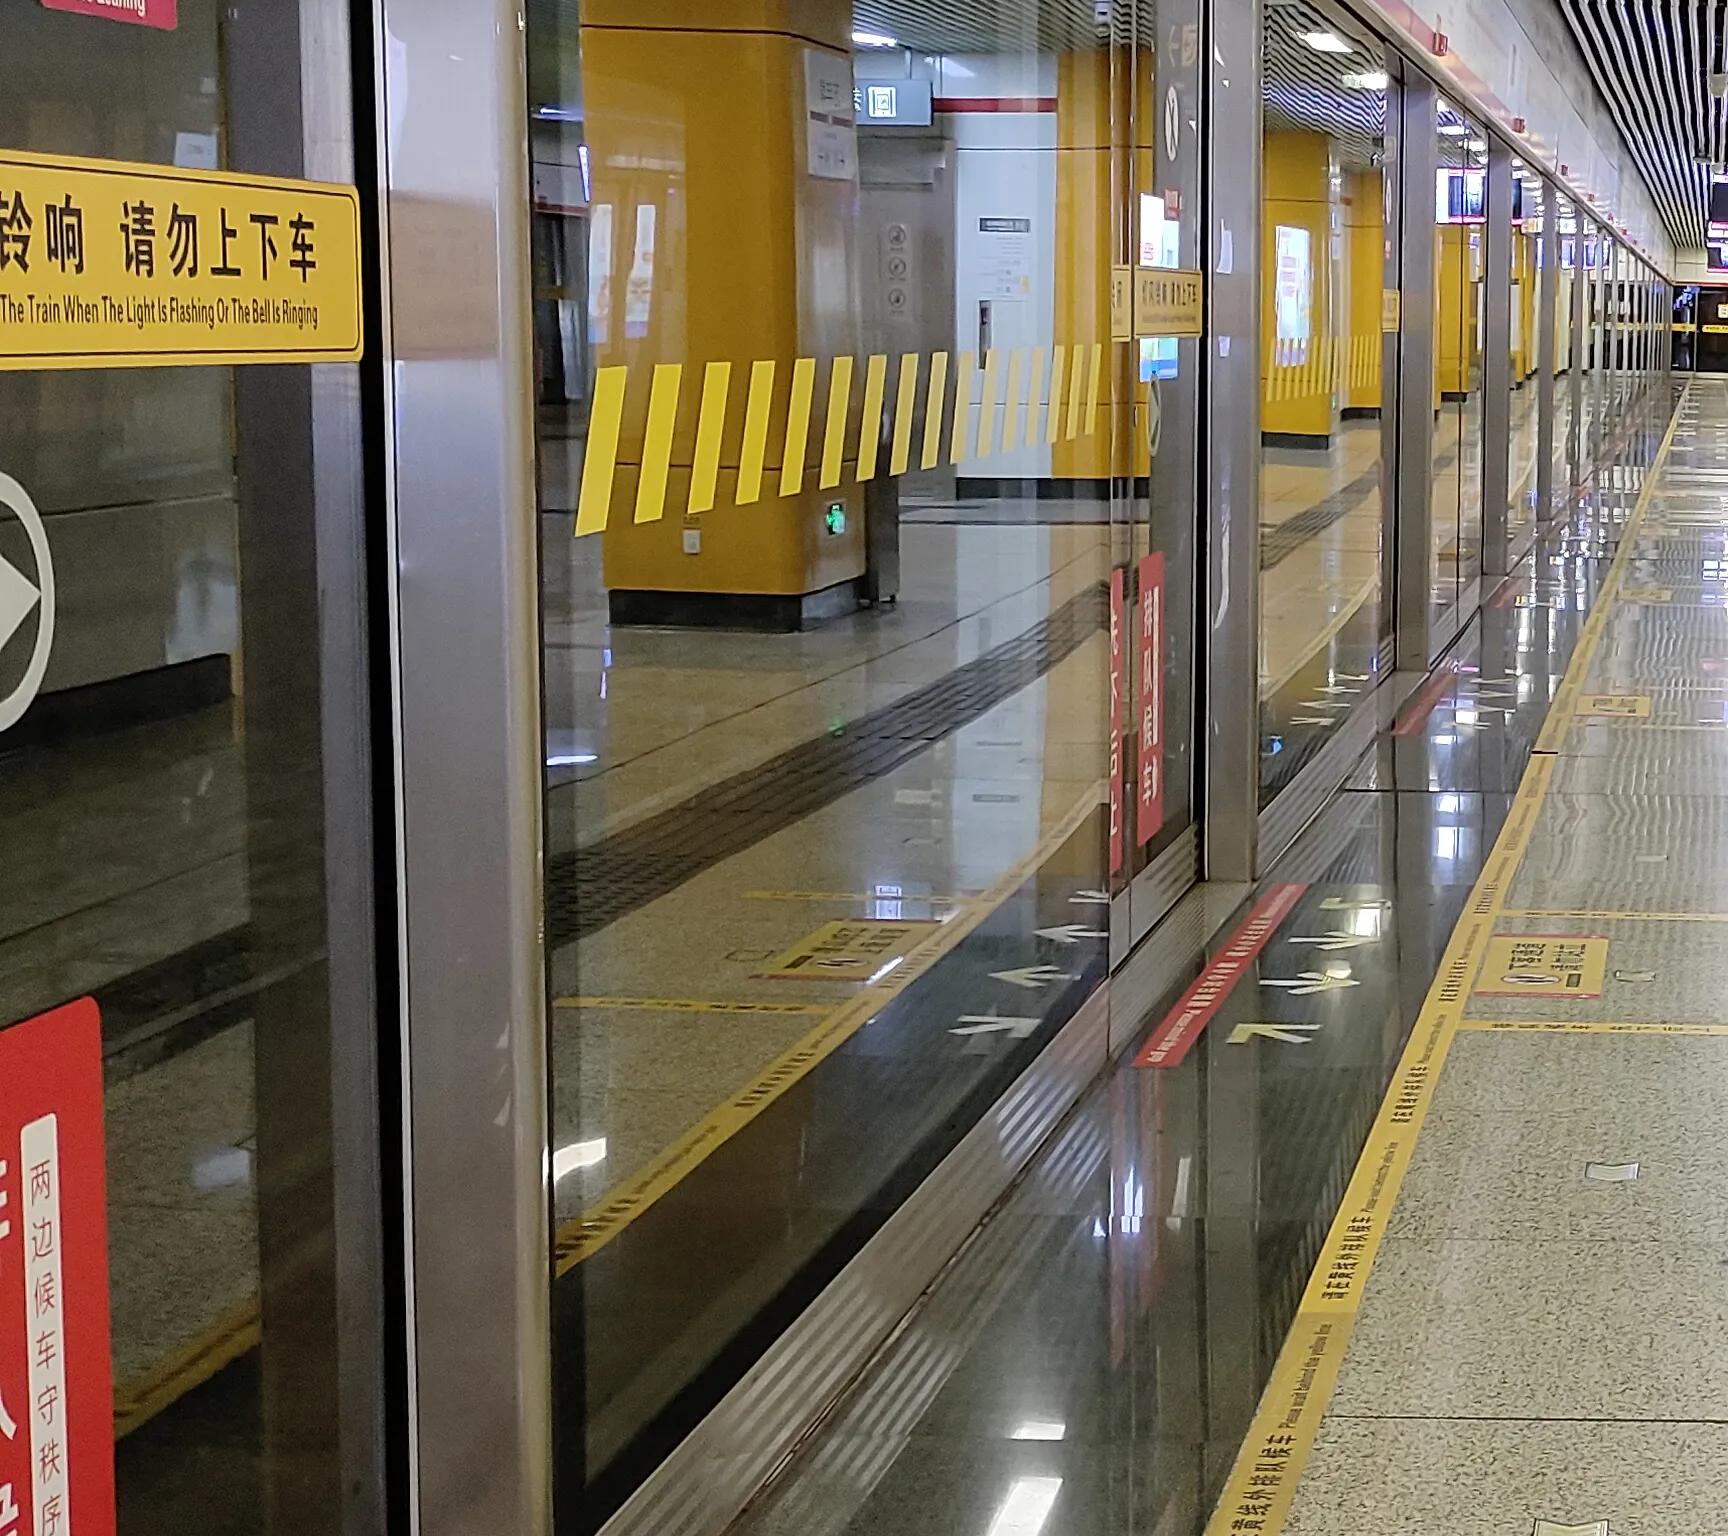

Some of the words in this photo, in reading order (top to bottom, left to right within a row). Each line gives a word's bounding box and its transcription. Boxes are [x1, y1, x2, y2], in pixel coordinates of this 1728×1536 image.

[119, 200, 317, 284] 请勿上下车
[0, 294, 24, 323] The
[27, 294, 60, 324] Train
[63, 294, 99, 324] When
[101, 295, 124, 324] The
[126, 295, 156, 330] Light
[157, 296, 168, 324] Is
[169, 295, 214, 331] Flashing
[216, 296, 229, 324] Or
[231, 297, 251, 324] The
[252, 297, 271, 324] Bell
[272, 298, 281, 324] Is
[282, 298, 319, 331] Ringing
